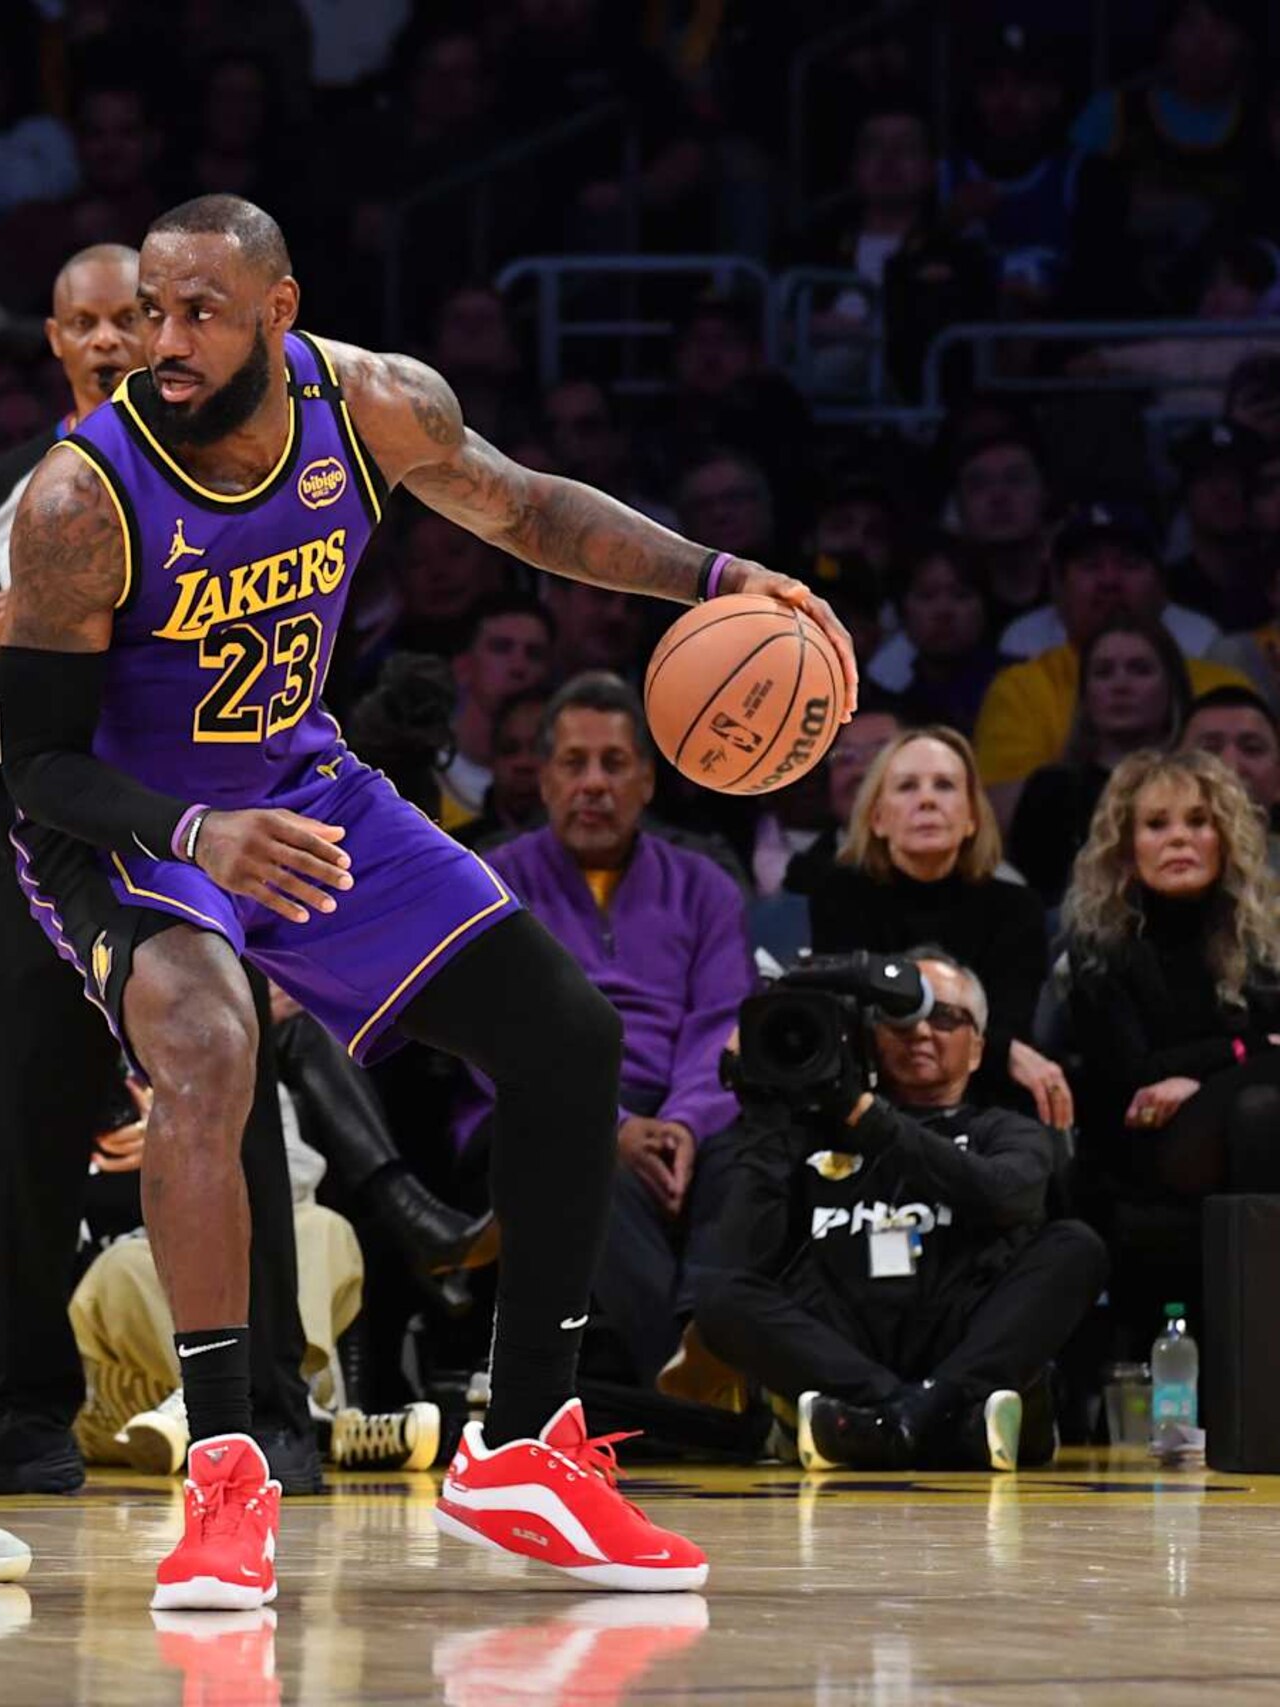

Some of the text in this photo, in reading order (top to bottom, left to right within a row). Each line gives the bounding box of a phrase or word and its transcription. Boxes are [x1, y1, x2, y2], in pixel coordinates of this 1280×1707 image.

[303, 385, 320, 398] 44
[302, 470, 343, 493] bibigo
[151, 529, 346, 641] LAKERS
[193, 612, 322, 742] 23
